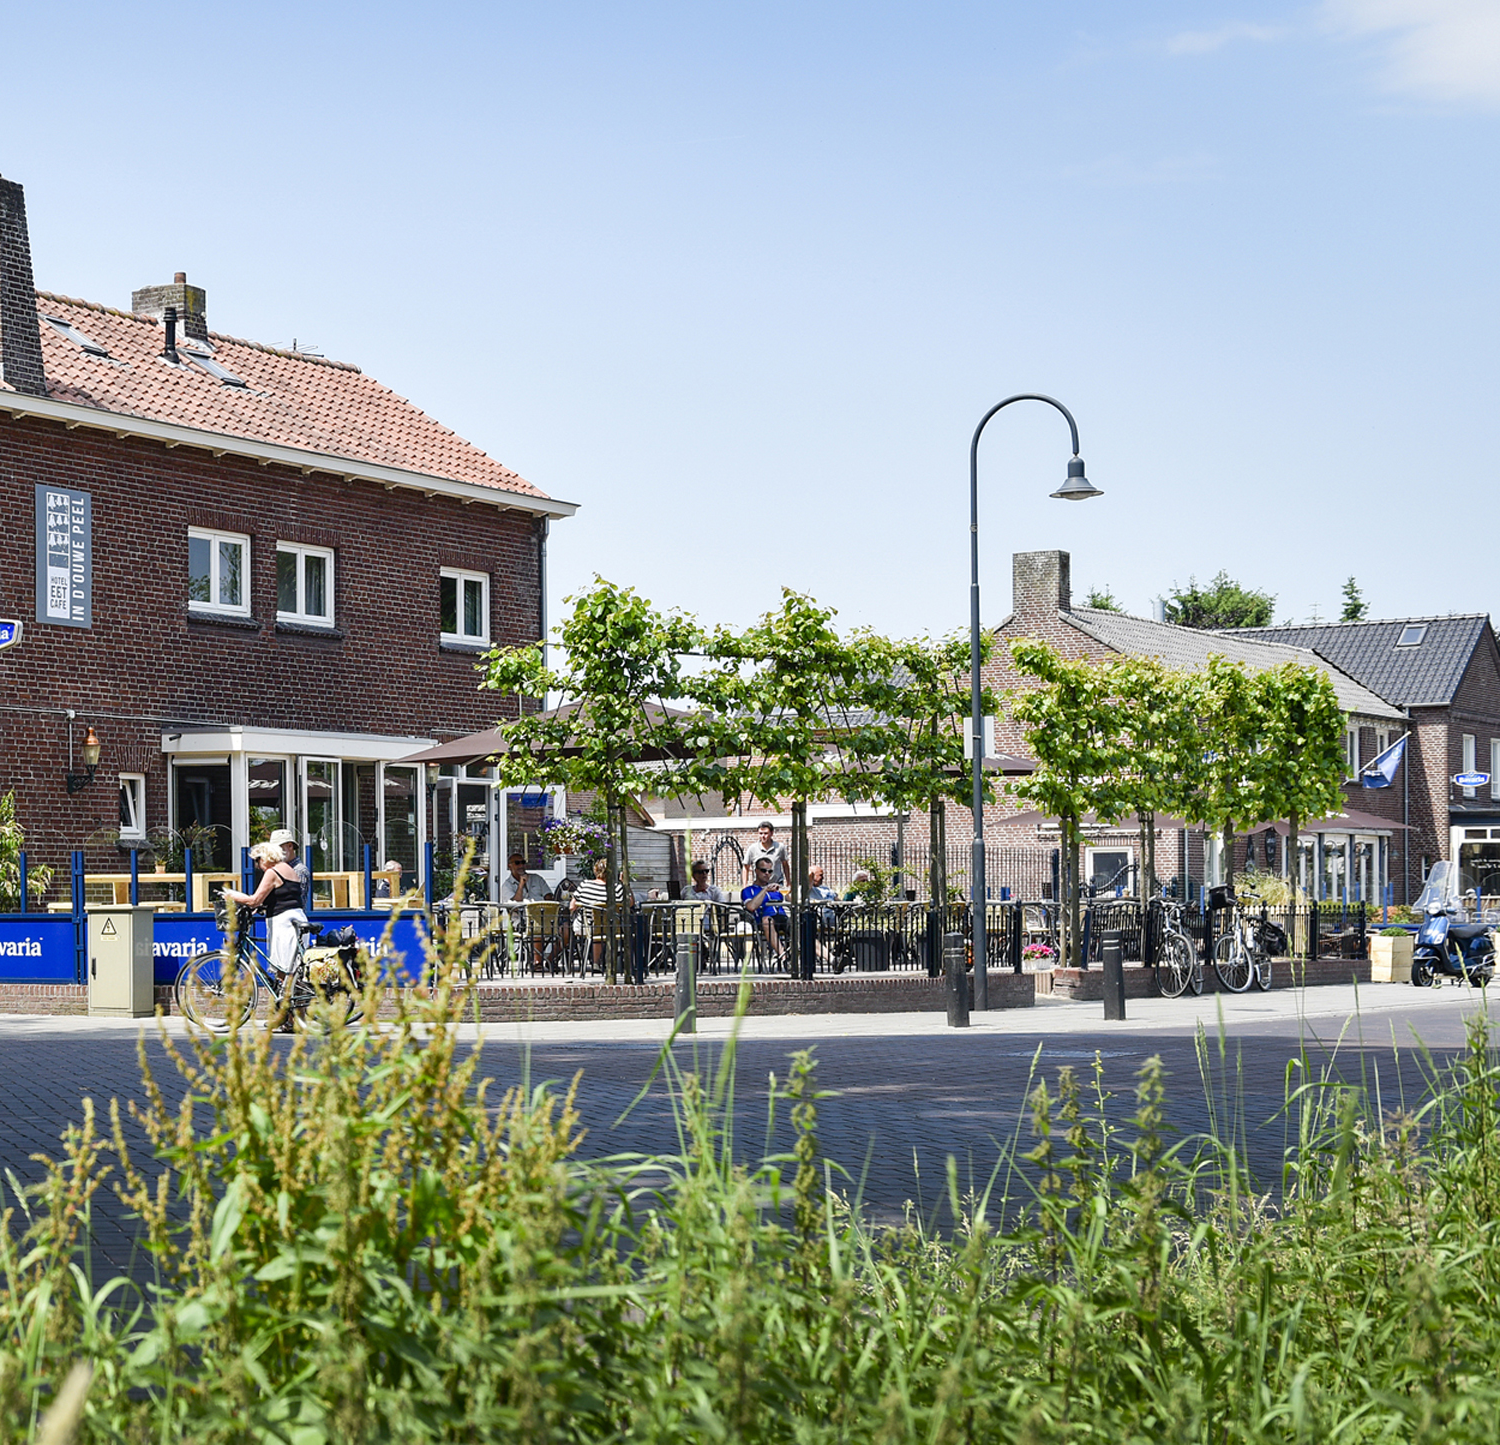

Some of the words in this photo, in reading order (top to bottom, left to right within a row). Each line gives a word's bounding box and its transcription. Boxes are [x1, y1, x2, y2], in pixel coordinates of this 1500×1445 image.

[72, 497, 85, 535] PEEL
[72, 540, 85, 600] D'OUWE
[50, 576, 68, 586] HOTEL
[72, 606, 85, 621] IN
[151, 937, 208, 958] avaria
